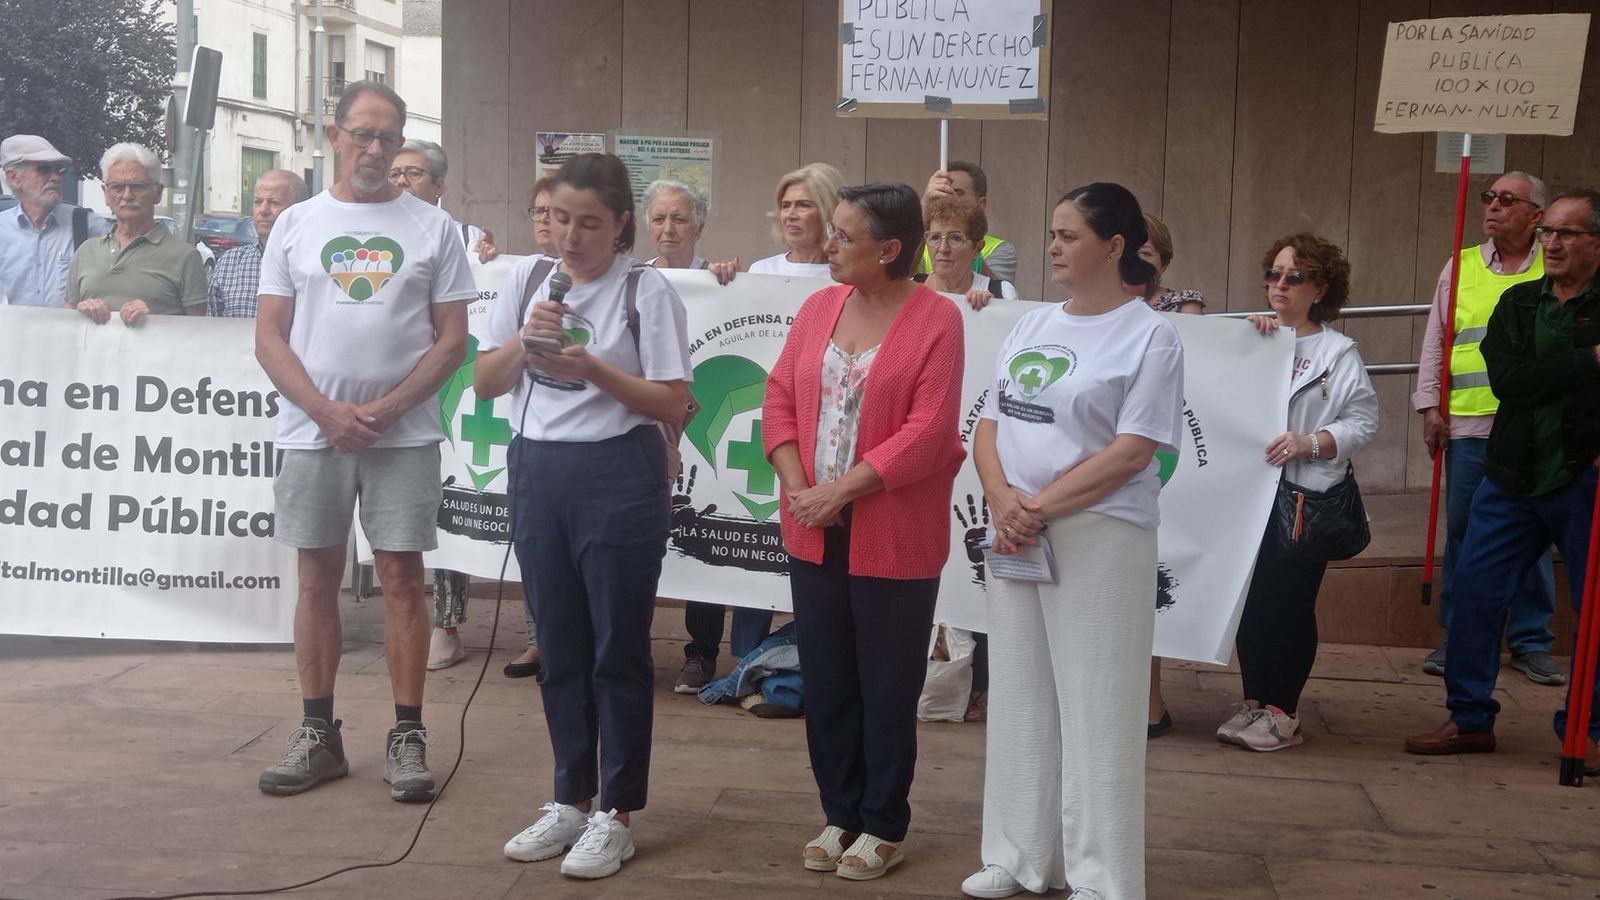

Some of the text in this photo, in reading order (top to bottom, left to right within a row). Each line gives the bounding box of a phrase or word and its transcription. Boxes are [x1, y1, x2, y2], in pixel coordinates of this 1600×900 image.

[932, 31, 1033, 58] DERECHO
[1396, 23, 1427, 41] POR
[1431, 27, 1453, 40] LA
[688, 338, 705, 358] MA
[704, 326, 722, 341] EN
[724, 314, 782, 332] DEFENSA
[720, 330, 756, 347] AGUILAR
[759, 329, 769, 337] DE
[64, 382, 119, 410] en
[0, 430, 46, 468] al
[62, 432, 119, 470] de
[1184, 409, 1208, 468] PÚBLICA
[0, 490, 275, 537] dad Pública
[452, 515, 463, 526] NO
[480, 505, 492, 515] UN
[496, 506, 509, 517] DE
[701, 528, 740, 542] SALUD
[744, 533, 758, 544] ES
[762, 535, 778, 546] UN
[711, 546, 728, 556] NO
[732, 548, 748, 559] UN
[0, 561, 280, 590] talmontilla@gmail.com
